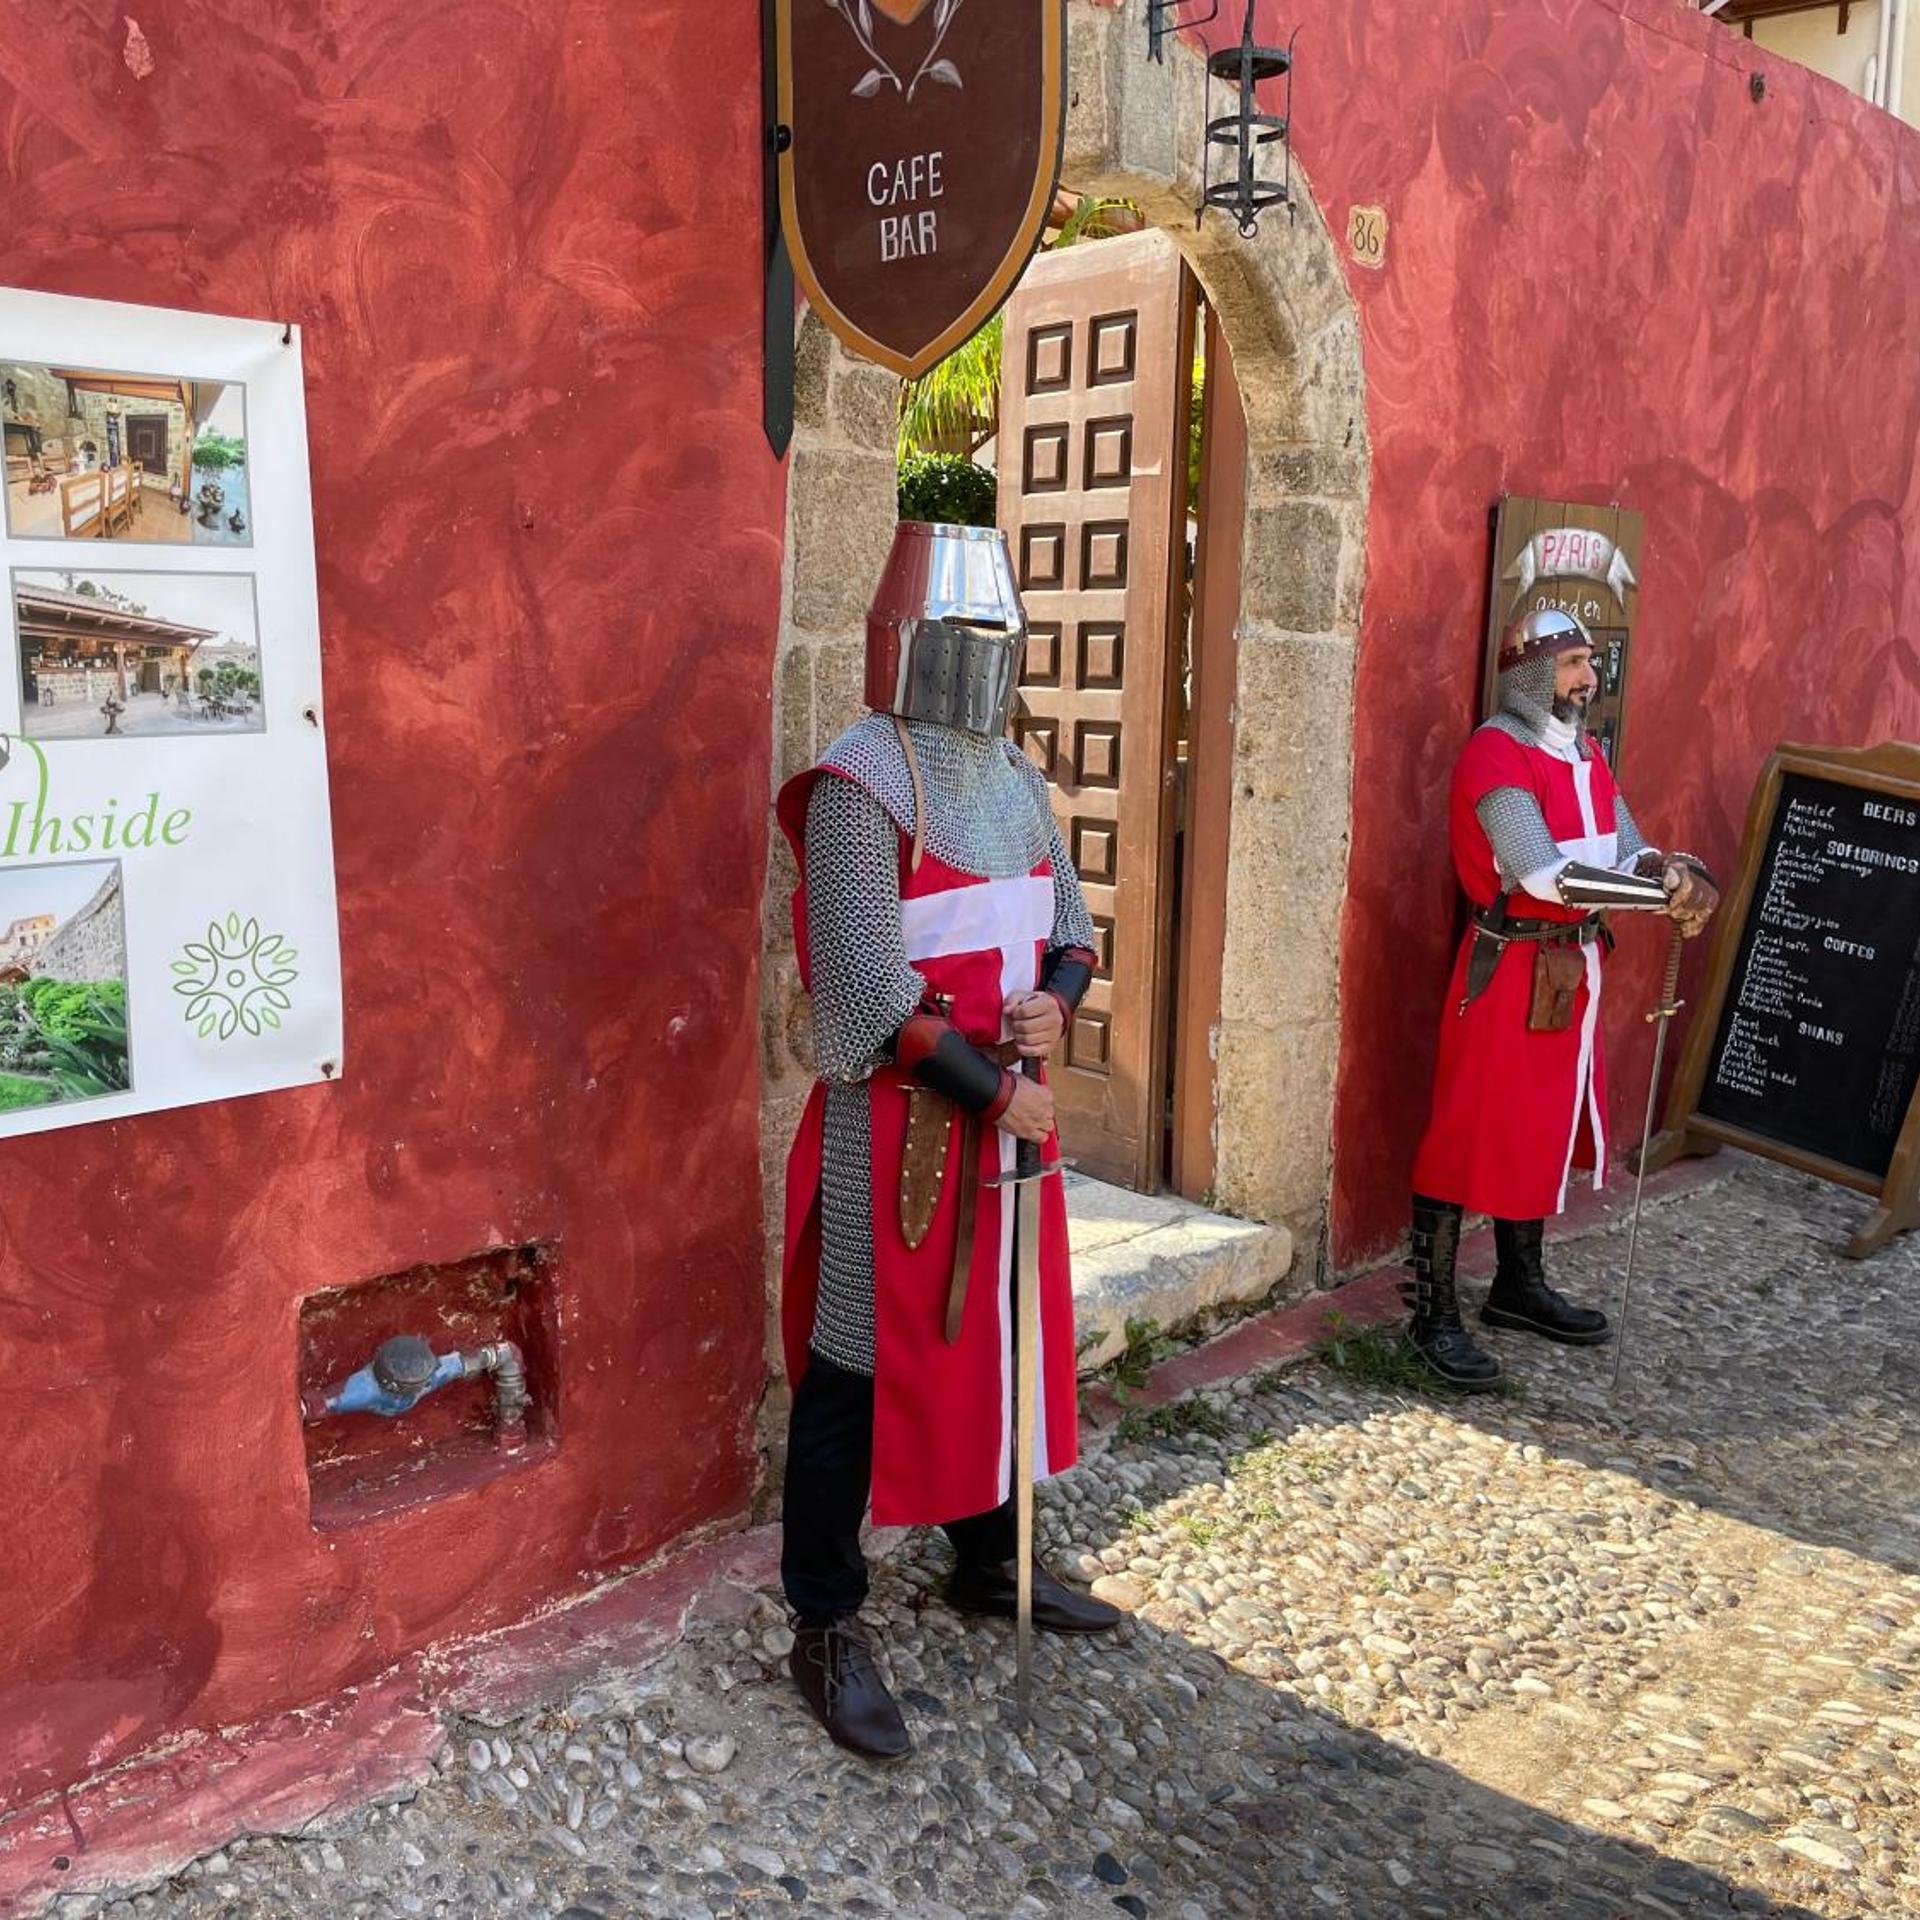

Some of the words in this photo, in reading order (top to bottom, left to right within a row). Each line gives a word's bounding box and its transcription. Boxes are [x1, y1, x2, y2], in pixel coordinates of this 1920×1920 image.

[867, 152, 944, 206] CAFE
[880, 210, 937, 262] BAR
[1354, 214, 1379, 255] 86
[1863, 801, 1917, 827] BEERS
